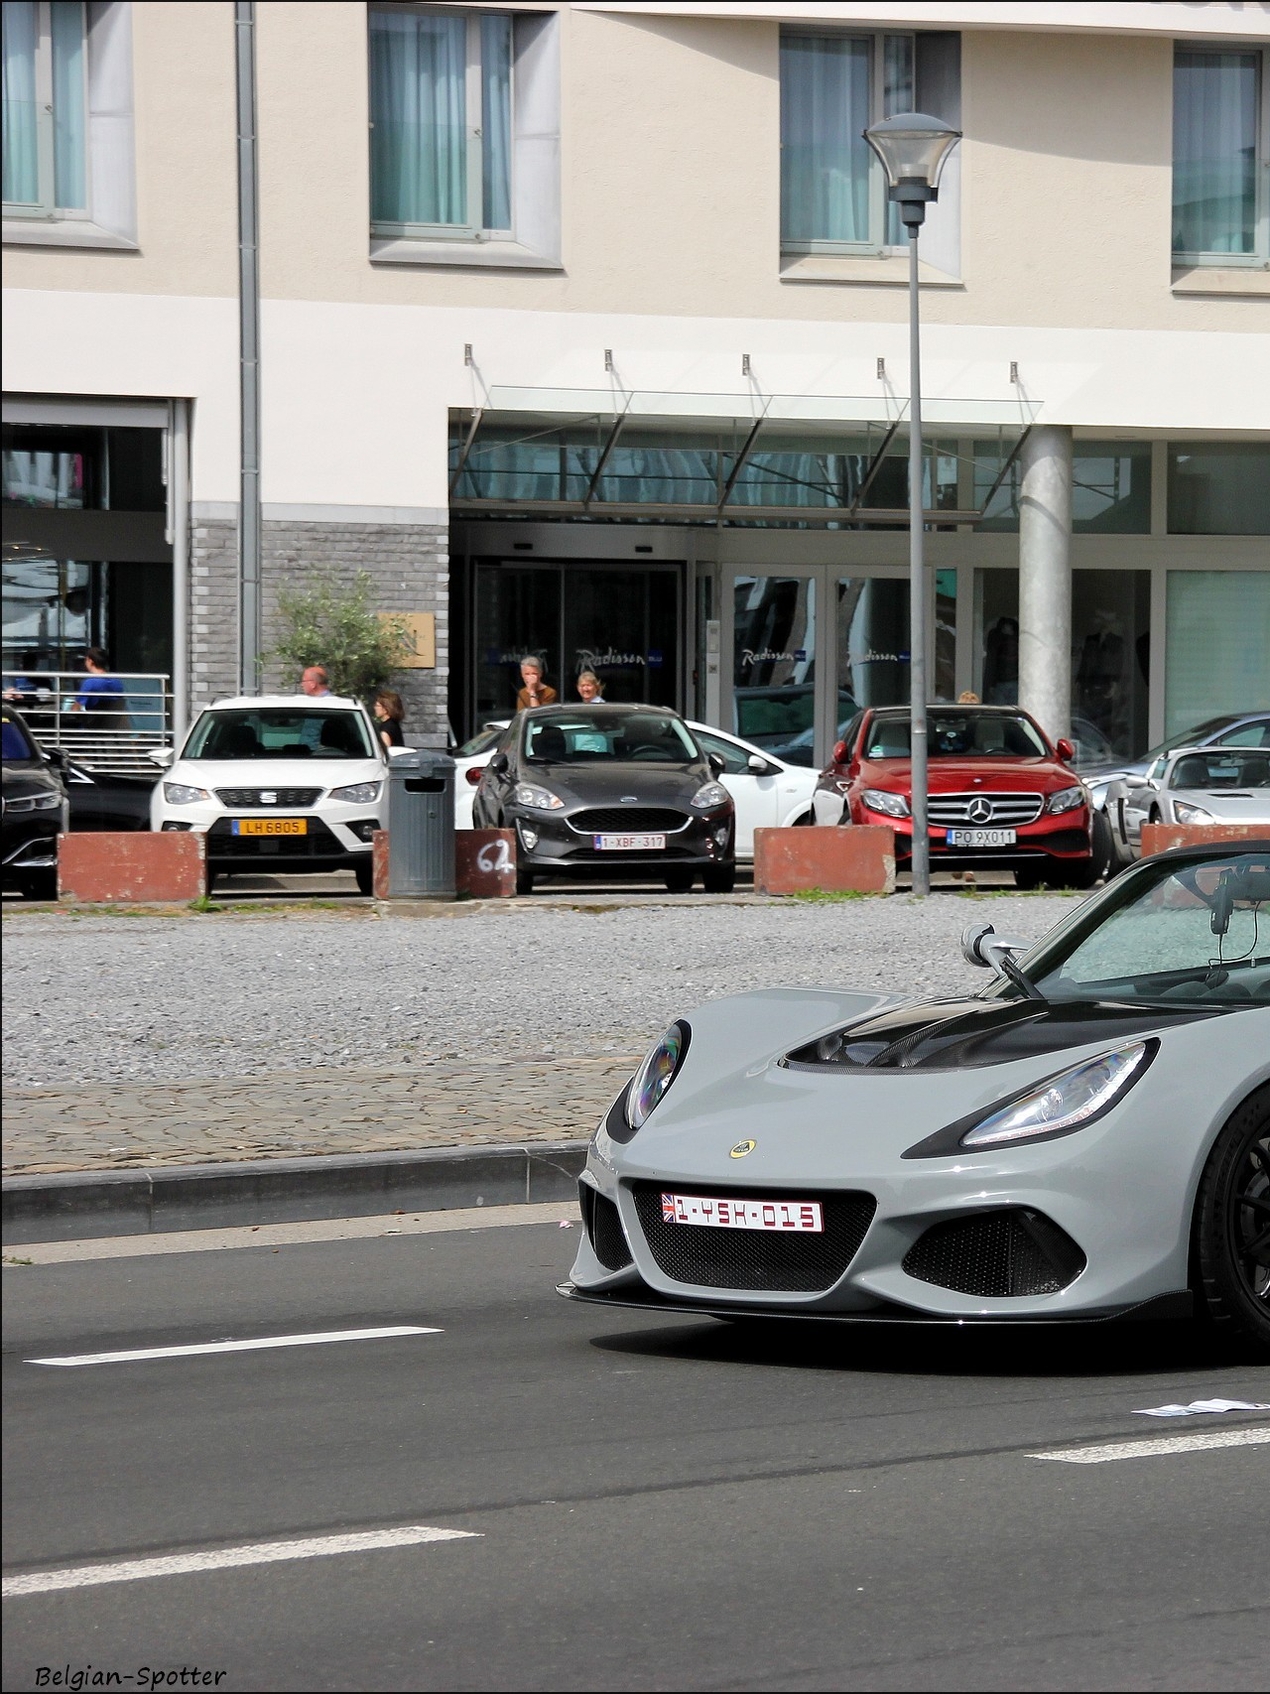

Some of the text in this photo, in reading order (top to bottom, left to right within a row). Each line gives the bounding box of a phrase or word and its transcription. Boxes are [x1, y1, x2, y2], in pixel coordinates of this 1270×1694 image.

[576, 645, 646, 673] Radisson
[742, 647, 795, 667] Radisson
[246, 822, 300, 834] LH 6805
[603, 836, 663, 848] 1-XBF-317
[955, 831, 1012, 844] PO 9X011
[677, 1198, 815, 1228] 1-YSH-015
